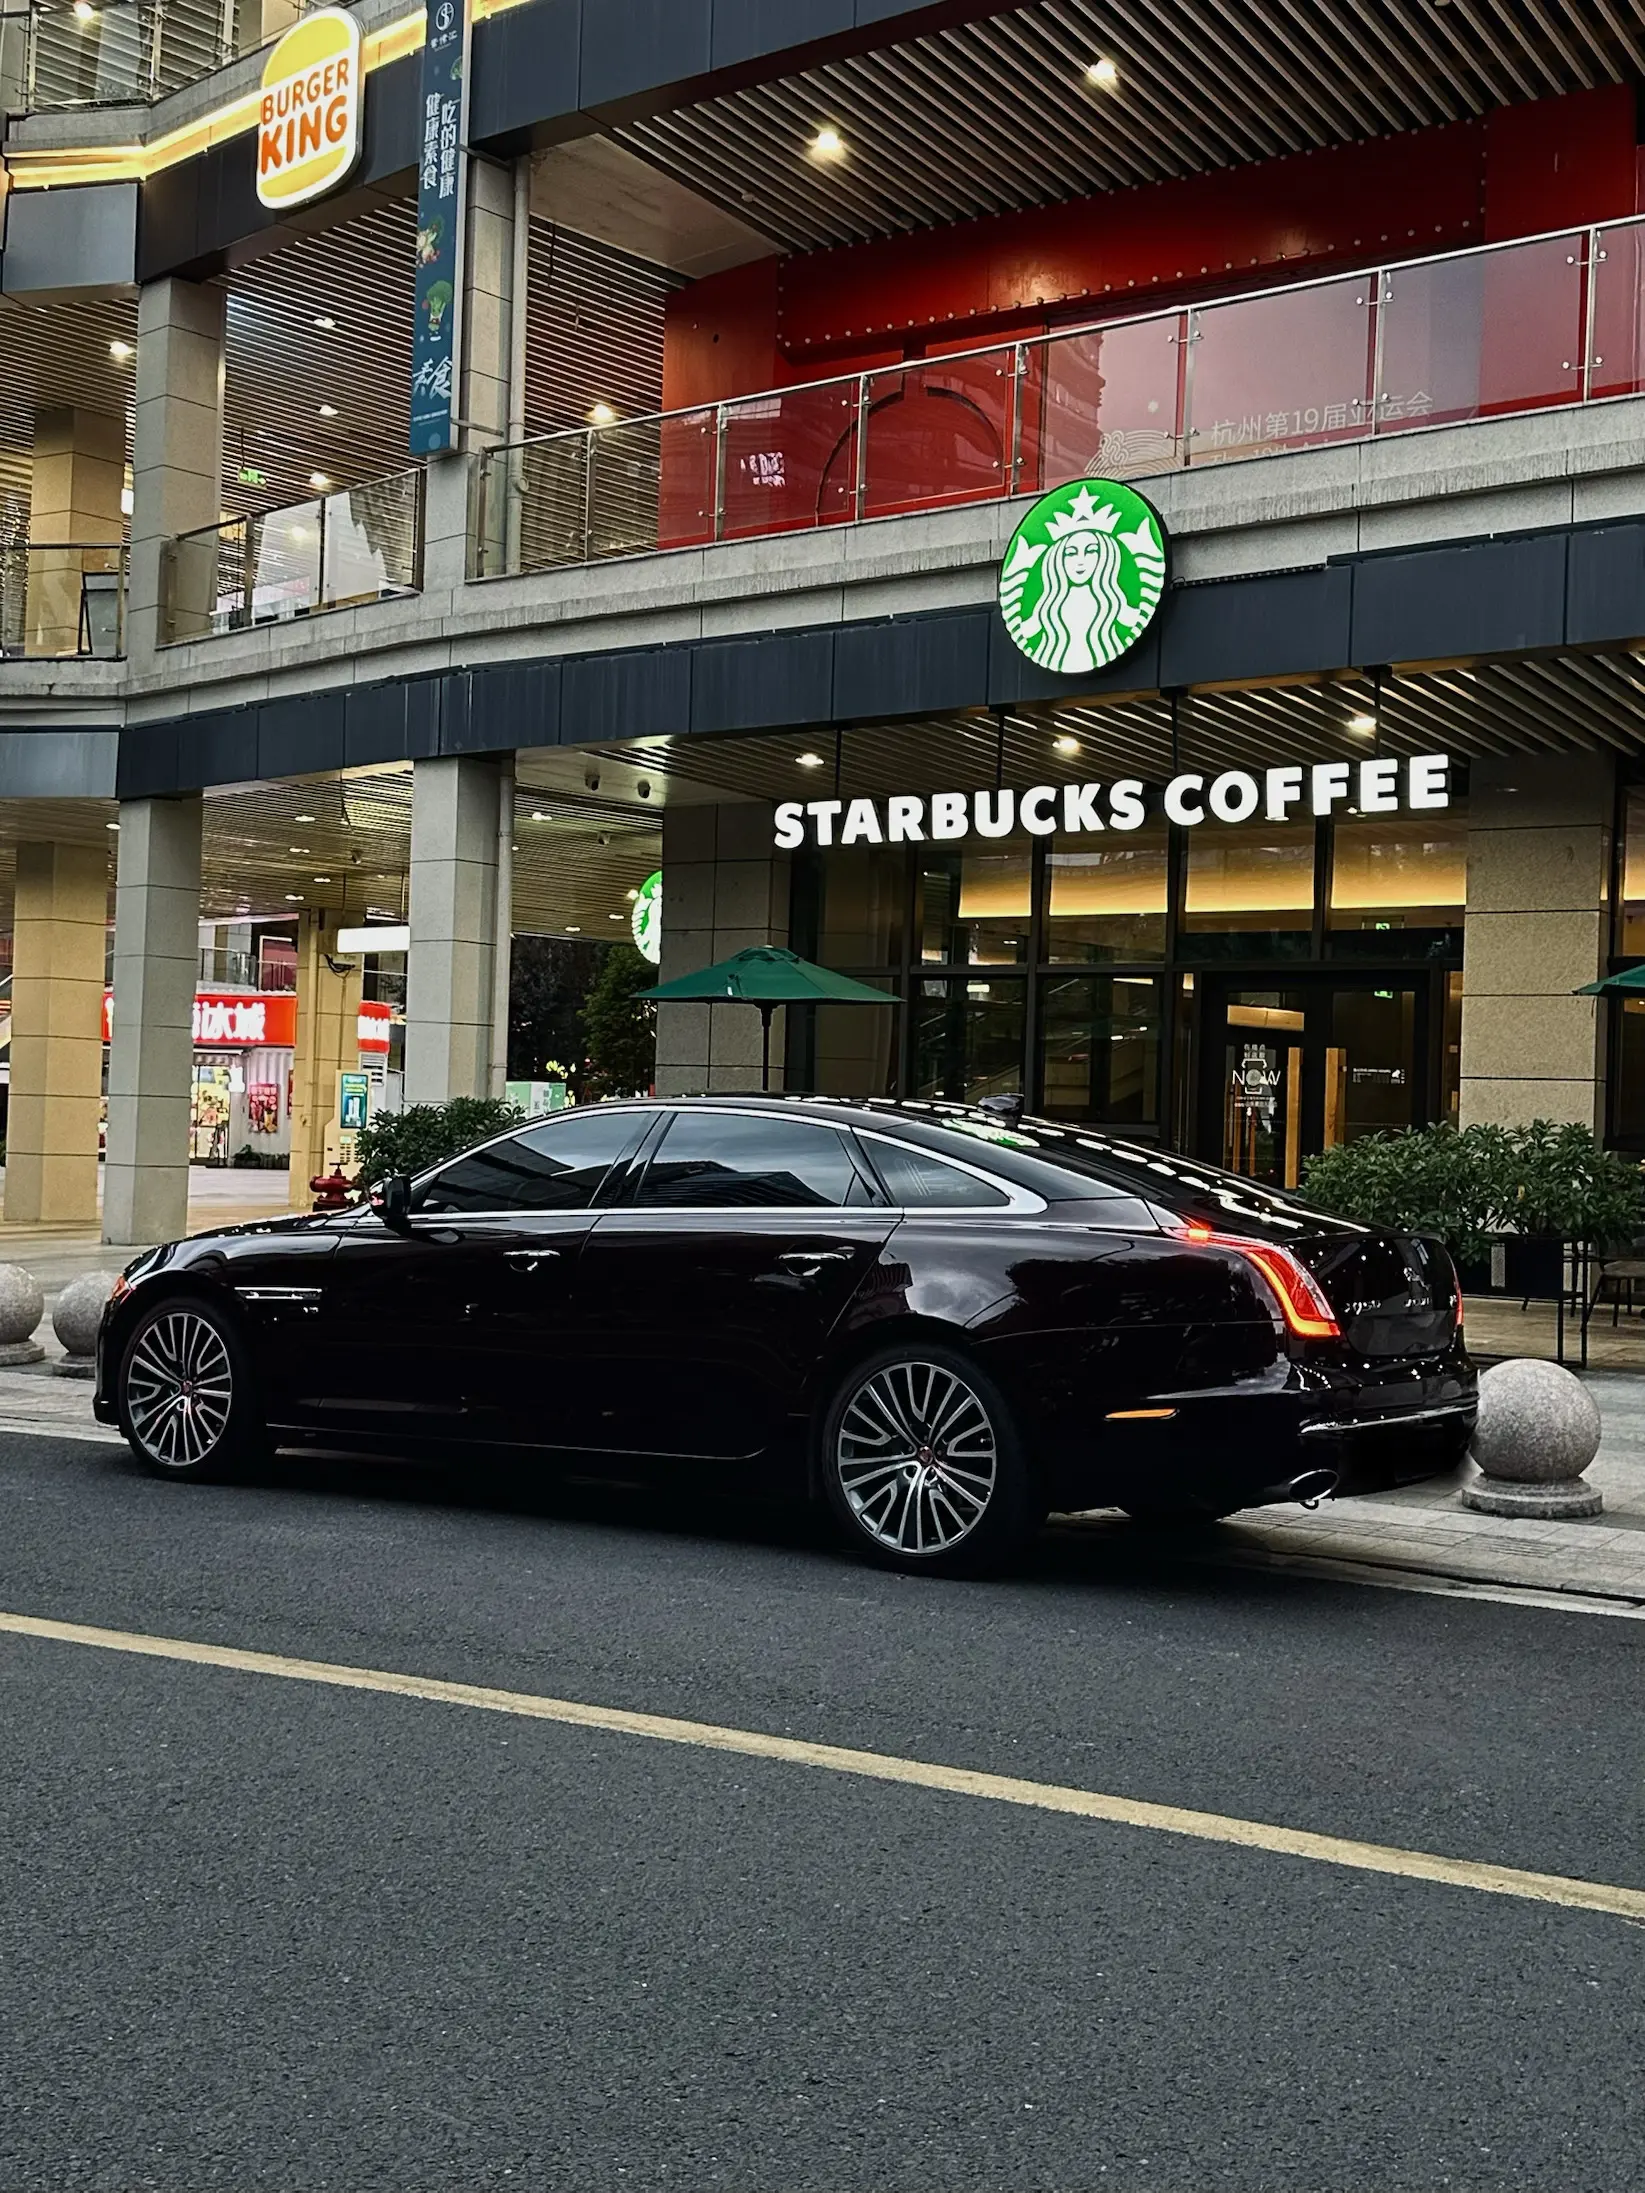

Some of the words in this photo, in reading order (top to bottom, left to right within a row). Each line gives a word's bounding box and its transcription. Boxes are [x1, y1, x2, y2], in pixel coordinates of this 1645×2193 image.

[260, 57, 349, 125] BURGER
[260, 94, 348, 176] KING
[420, 92, 444, 190] 健康素食
[439, 98, 461, 199] 吃的健康
[773, 779, 1145, 849] STARBUCKS
[1163, 754, 1449, 827] COFFEE
